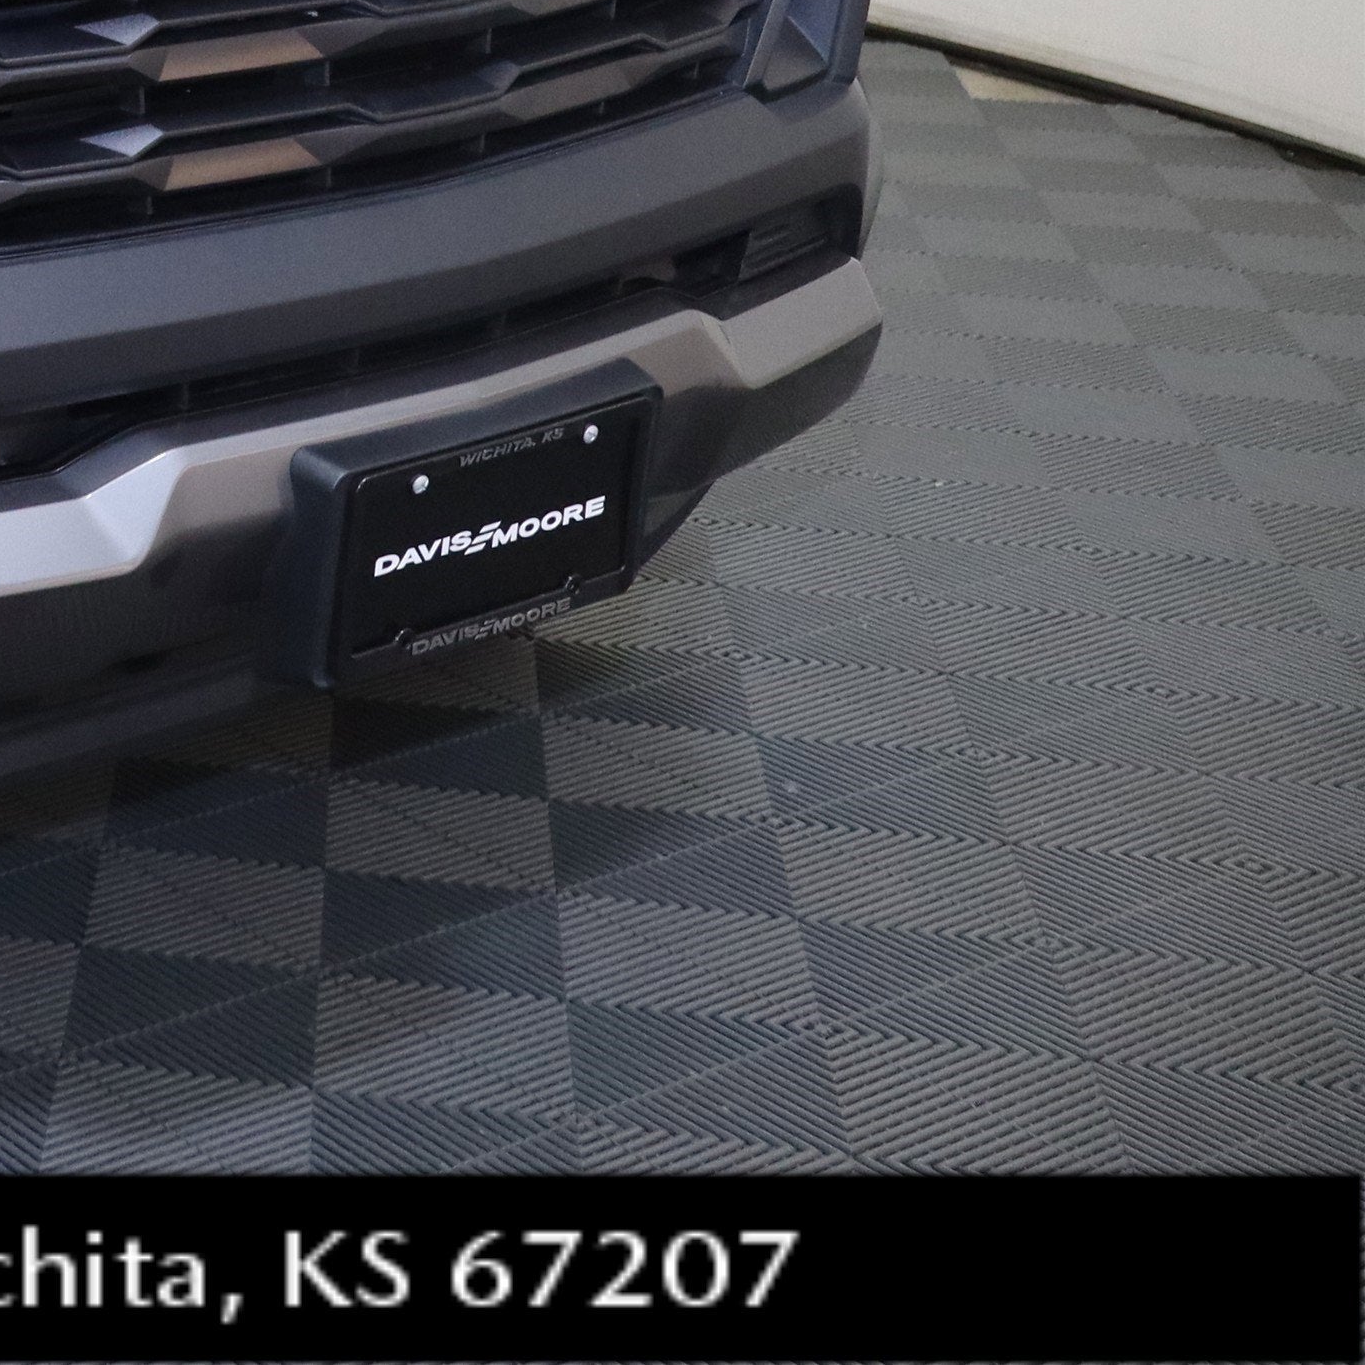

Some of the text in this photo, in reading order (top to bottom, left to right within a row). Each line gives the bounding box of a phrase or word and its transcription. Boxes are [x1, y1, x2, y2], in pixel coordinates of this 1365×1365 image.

[541, 428, 564, 443] KS
[374, 495, 606, 577] DAVIS MOORE
[493, 597, 571, 635] MOORE
